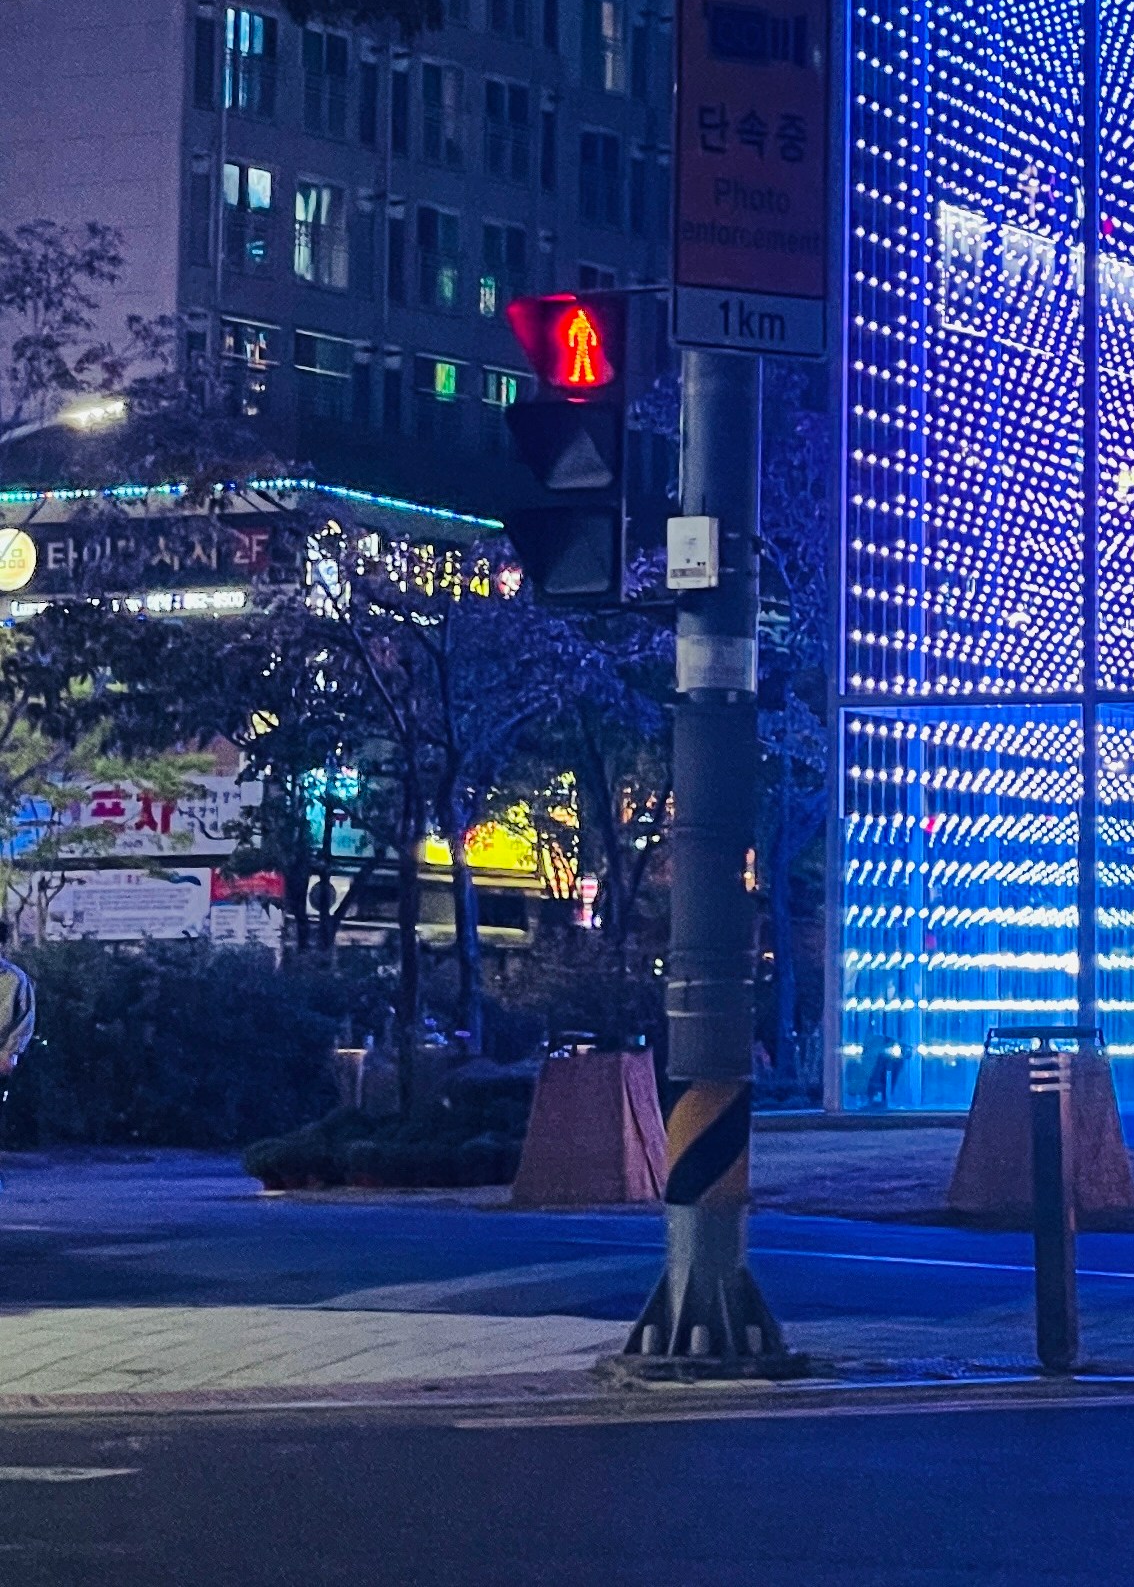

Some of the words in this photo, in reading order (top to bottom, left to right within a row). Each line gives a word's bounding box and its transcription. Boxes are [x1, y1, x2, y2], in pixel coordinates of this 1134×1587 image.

[698, 102, 807, 163] 단속중
[713, 177, 791, 215] Photo
[681, 218, 820, 256] enforcement
[719, 300, 786, 342] 1km
